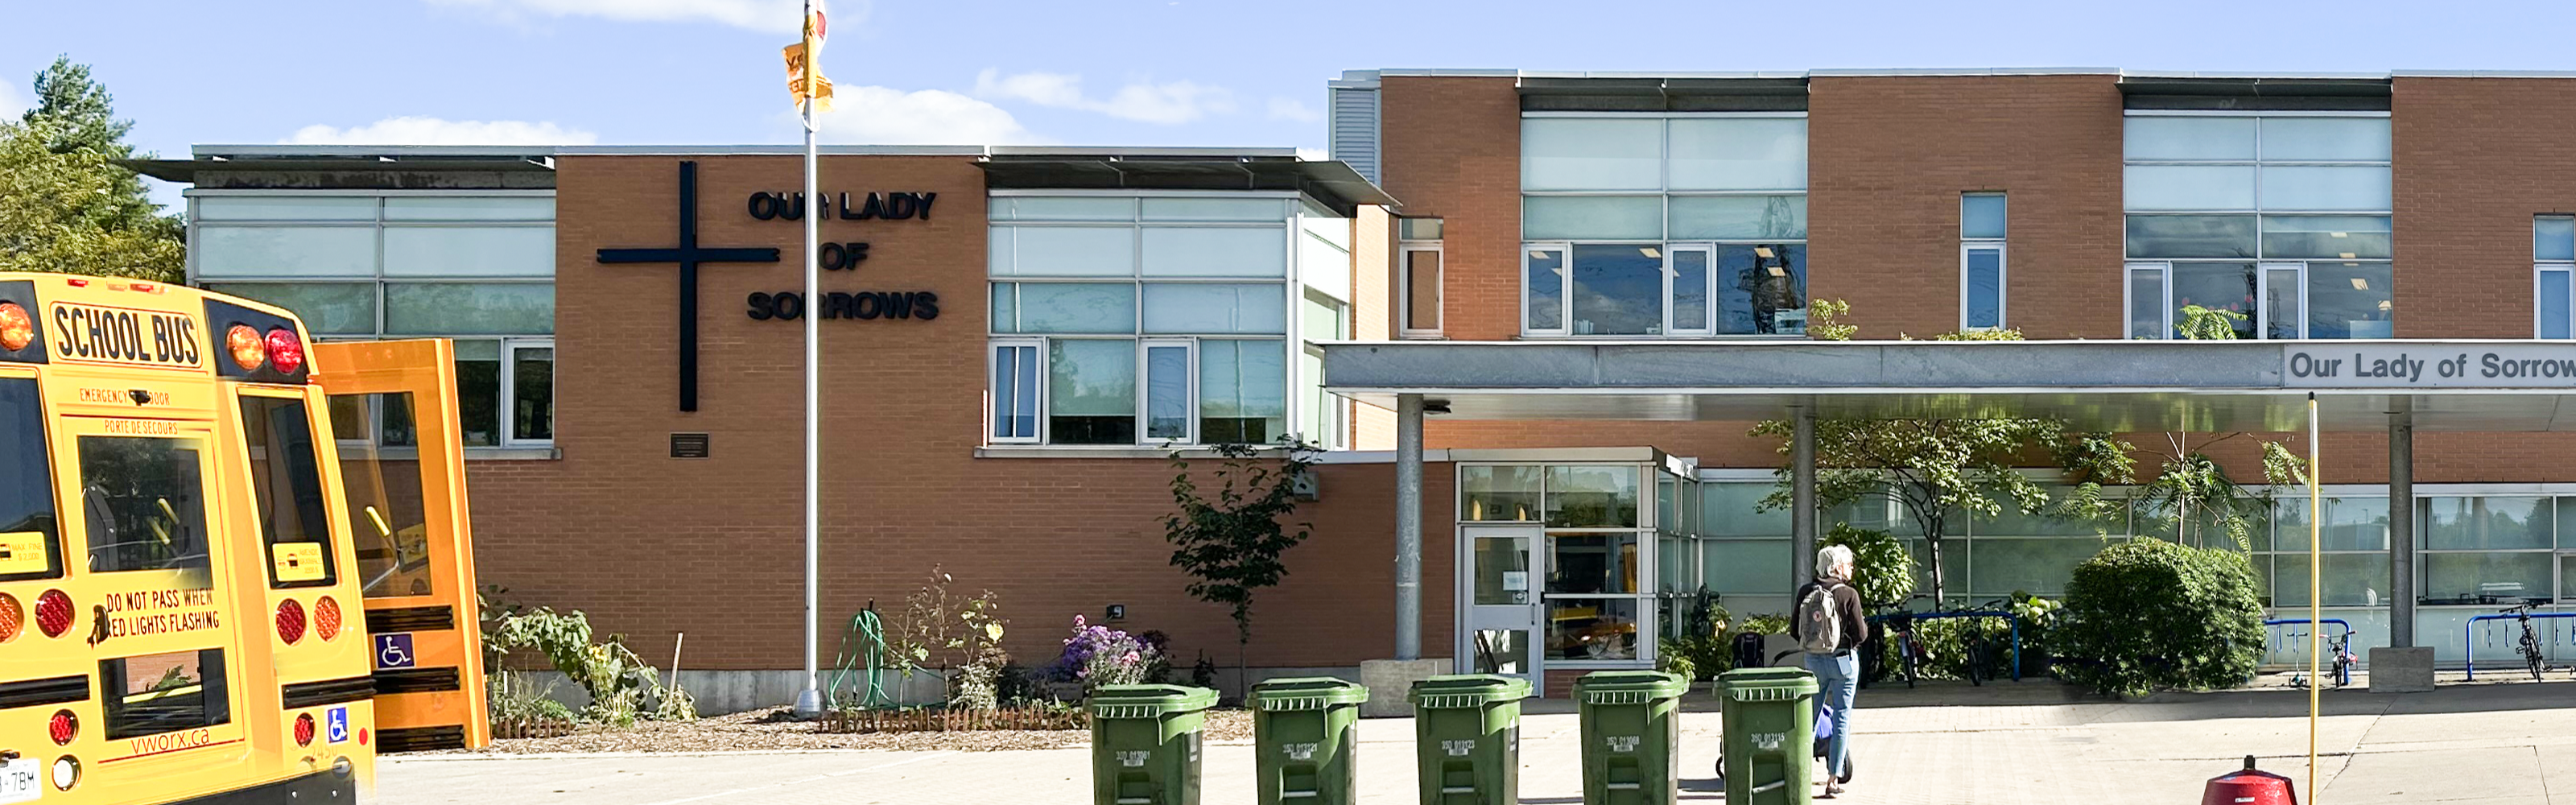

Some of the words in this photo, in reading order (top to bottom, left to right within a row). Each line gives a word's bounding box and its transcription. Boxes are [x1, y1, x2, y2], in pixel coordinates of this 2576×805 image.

[748, 192, 830, 221] OUR
[840, 192, 937, 221] LADY
[817, 242, 869, 271] OF
[55, 305, 151, 361] SCHOOL
[151, 314, 199, 365] BUS
[2290, 352, 2342, 378] Our
[2355, 353, 2425, 382] Lady
[2438, 353, 2467, 378] of
[2480, 352, 2576, 378] Sorrow
[79, 388, 127, 404] EMERGENCY
[105, 419, 129, 434] PORTE
[131, 420, 141, 434] DE
[142, 421, 178, 435] SECOURS
[106, 593, 122, 613] DO
[126, 591, 147, 612] NOT
[152, 589, 180, 609] PASS
[183, 587, 213, 607] WHEN
[108, 617, 126, 638] ED
[129, 614, 167, 636] LIGHTS
[169, 610, 220, 633] FLASHING
[130, 728, 209, 754] vworx.ca
